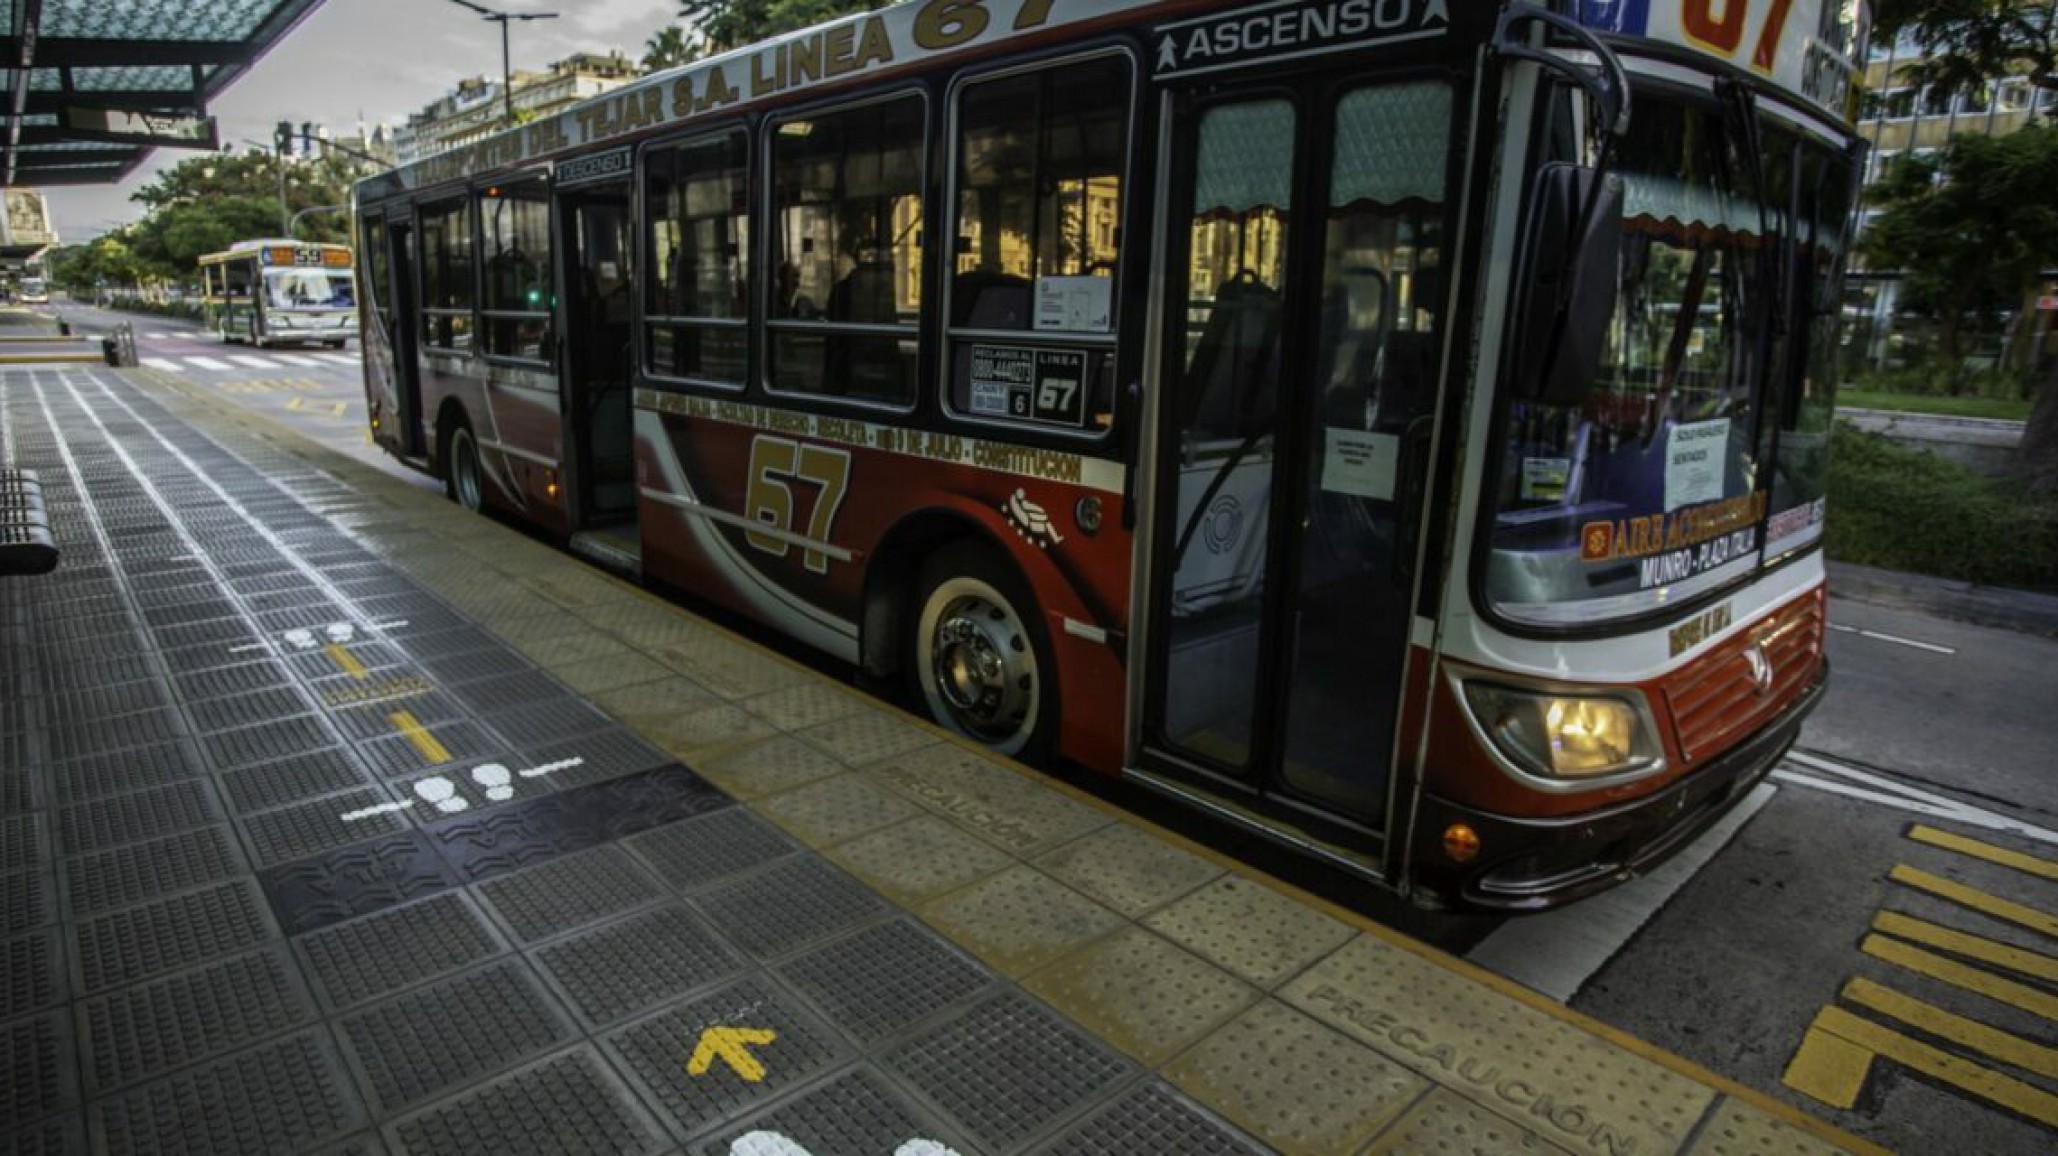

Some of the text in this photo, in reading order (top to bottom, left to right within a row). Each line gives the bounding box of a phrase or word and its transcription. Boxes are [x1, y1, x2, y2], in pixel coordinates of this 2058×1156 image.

[1183, 0, 1410, 59] ASCENSO
[574, 86, 664, 145] TEJAR
[672, 66, 740, 116] S.A.
[750, 14, 893, 97] LINEA
[1014, 393, 1026, 414] 6
[1037, 378, 1078, 412] 67
[746, 434, 852, 574] 67
[1640, 549, 1692, 589] MUNRO
